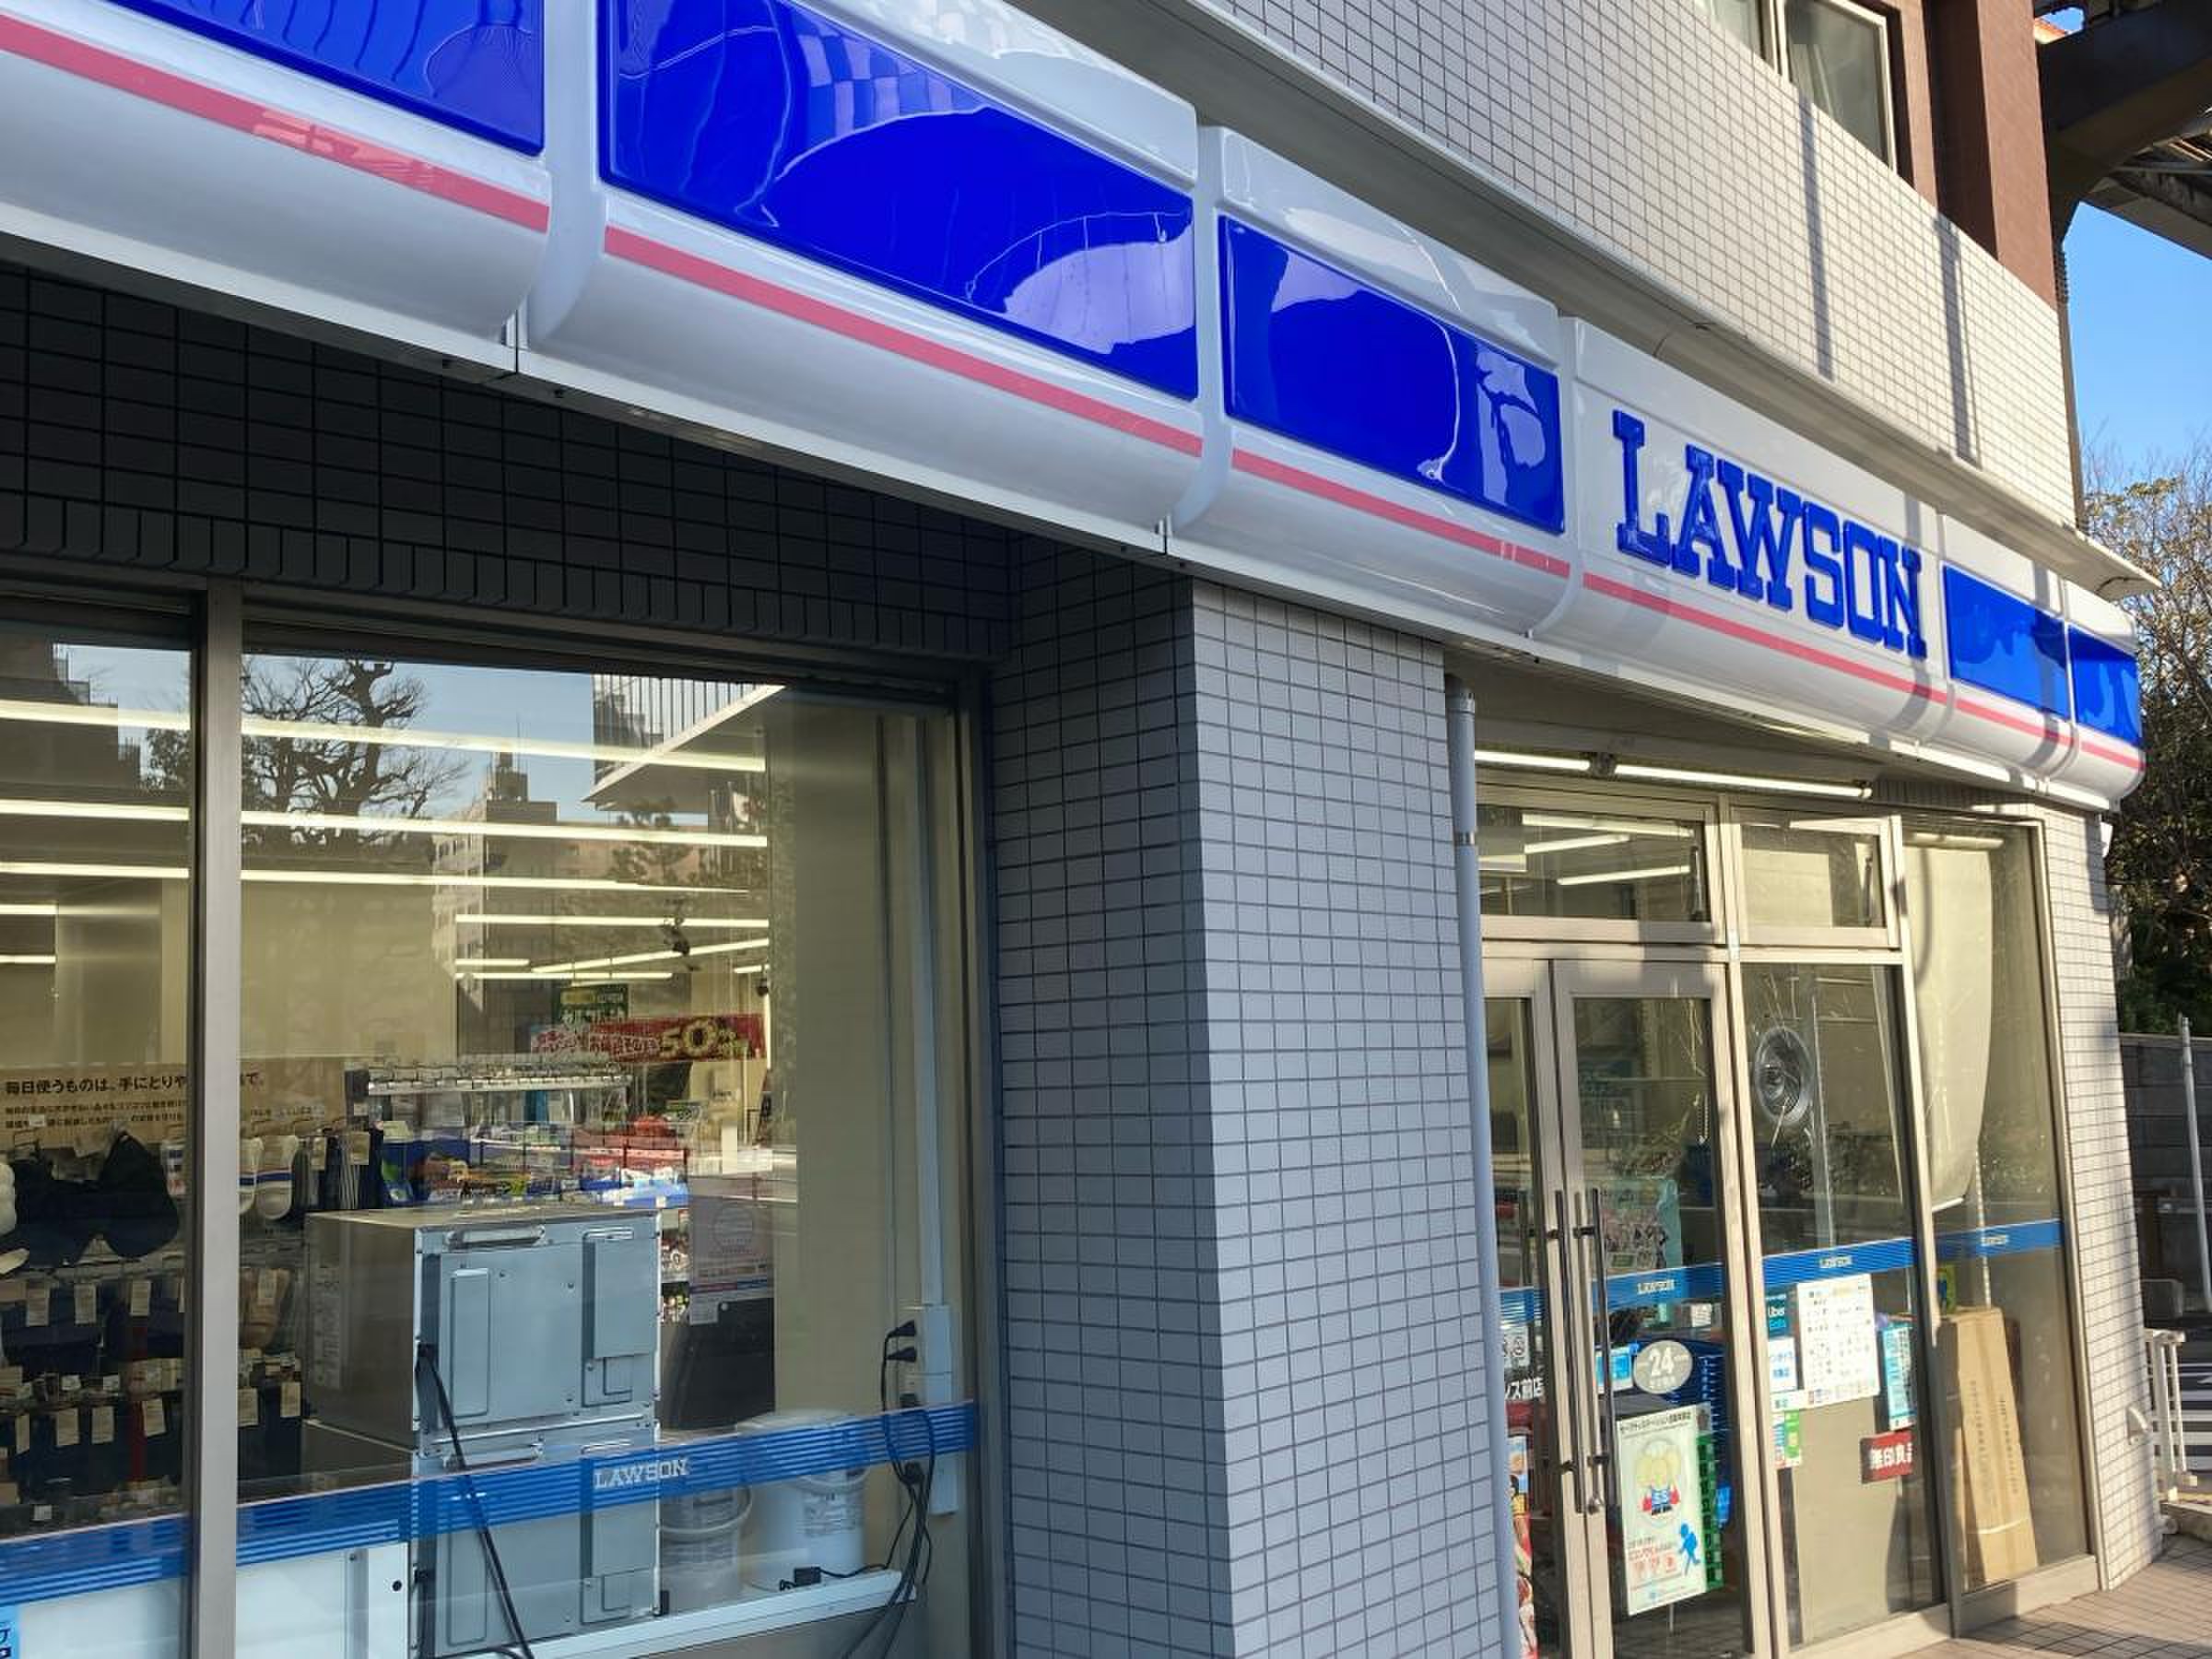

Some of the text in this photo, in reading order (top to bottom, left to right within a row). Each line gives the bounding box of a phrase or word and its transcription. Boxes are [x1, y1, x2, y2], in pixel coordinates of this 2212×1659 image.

[1611, 408, 1928, 661] LAWSON
[1649, 1347, 1675, 1376] 24
[594, 1458, 689, 1489] LAWSON
